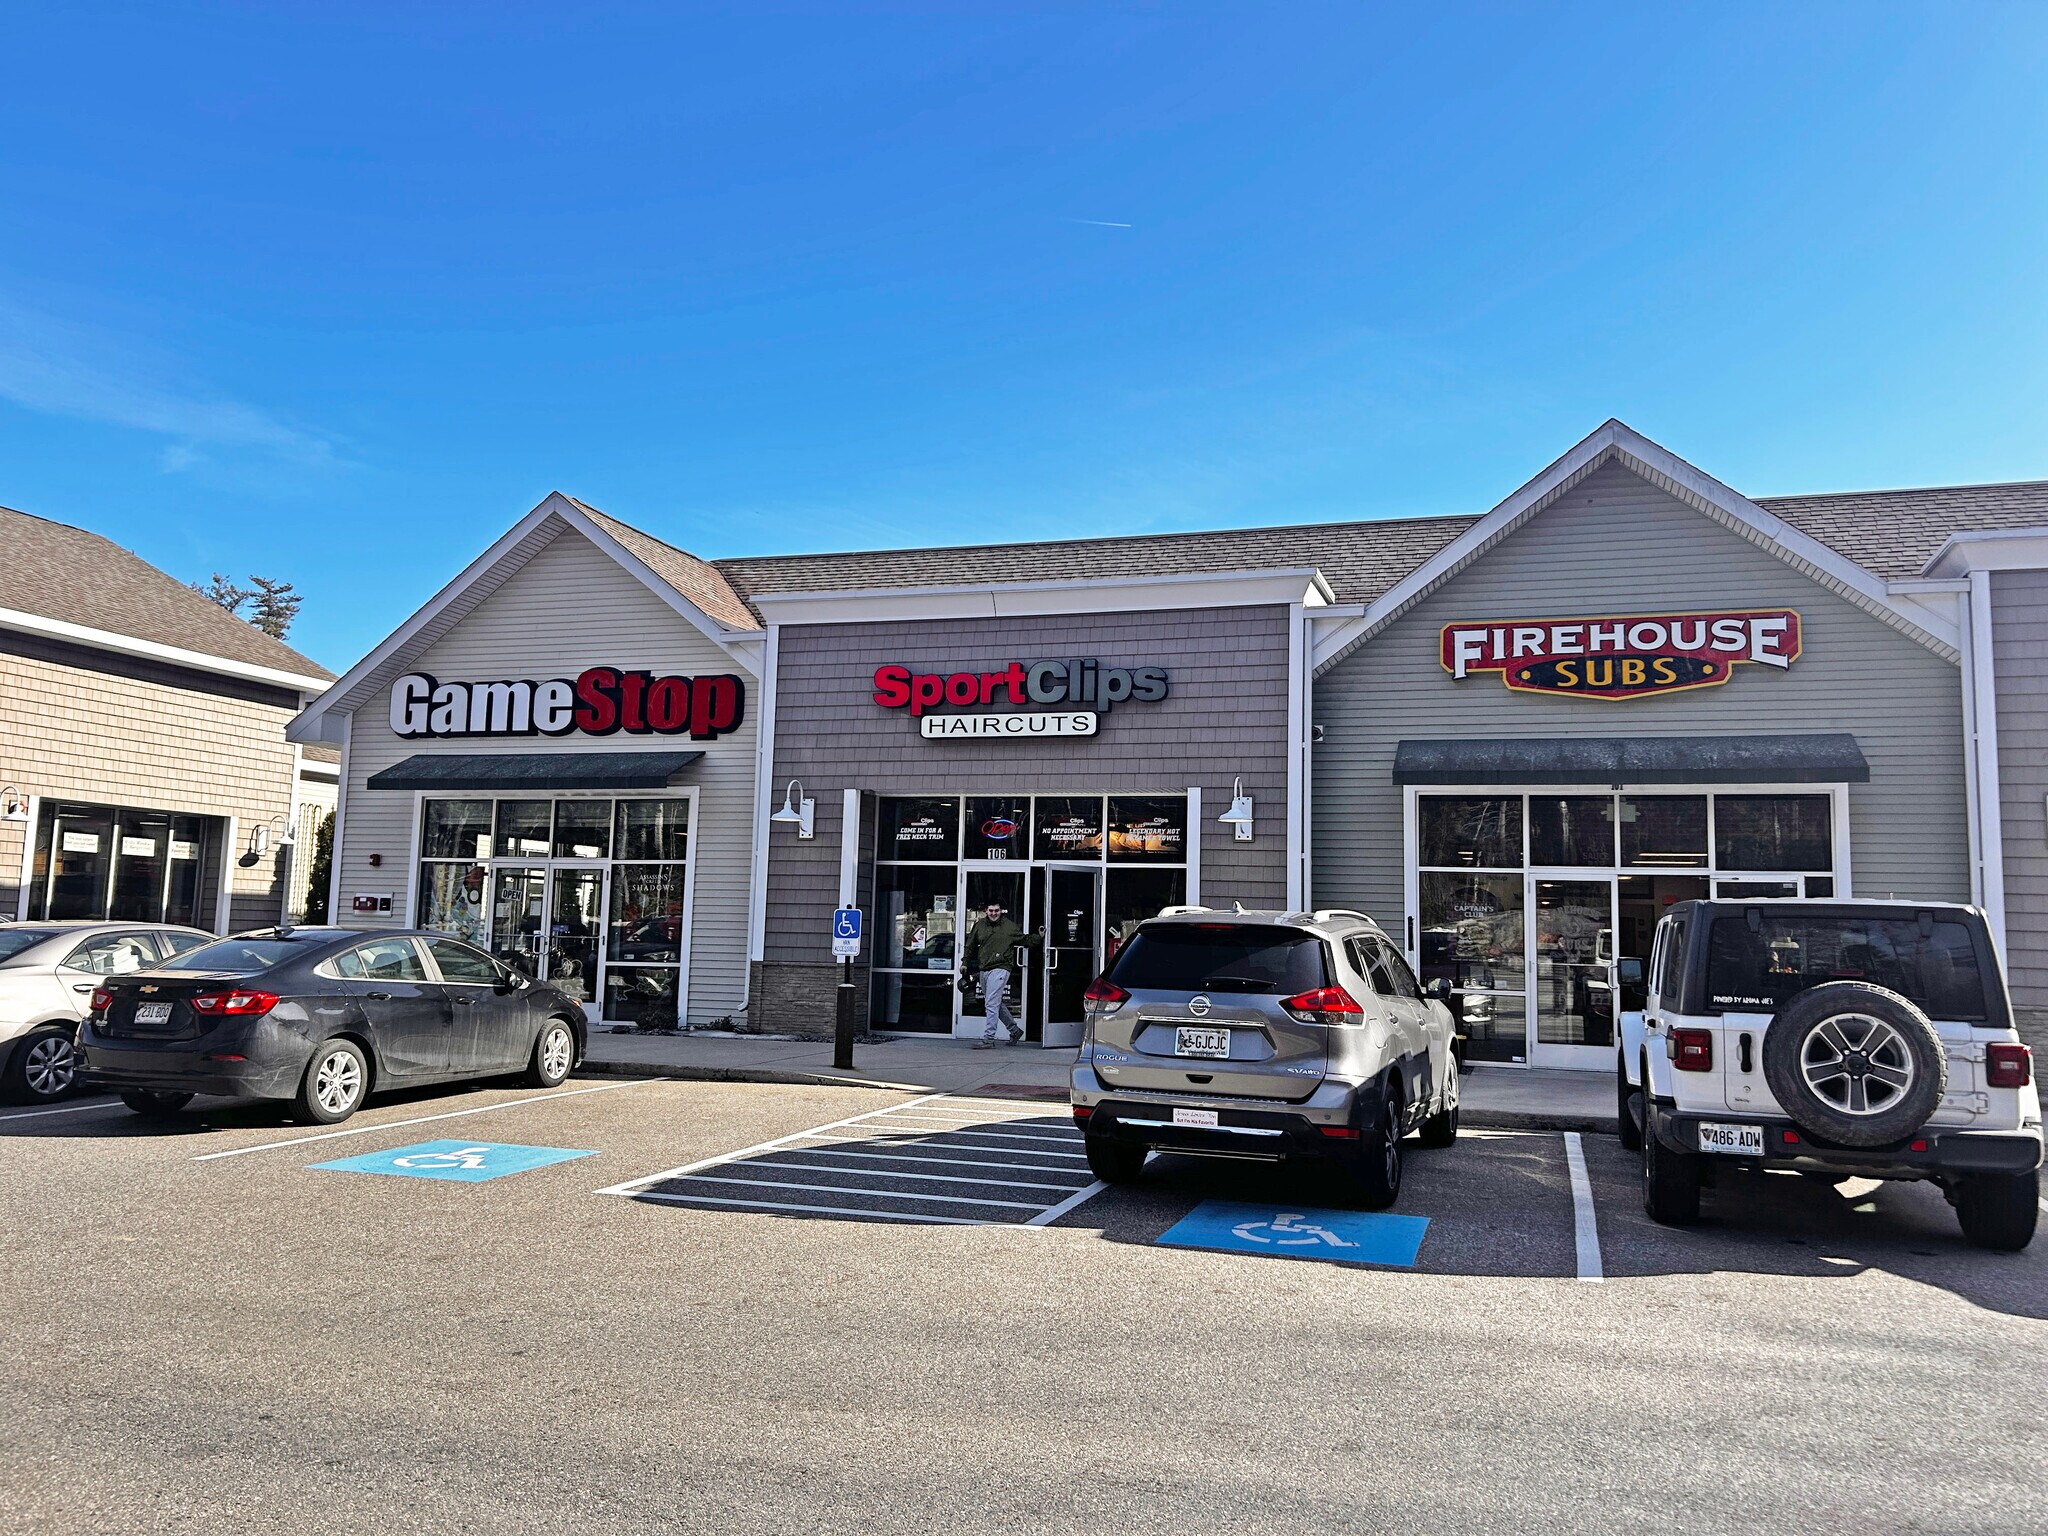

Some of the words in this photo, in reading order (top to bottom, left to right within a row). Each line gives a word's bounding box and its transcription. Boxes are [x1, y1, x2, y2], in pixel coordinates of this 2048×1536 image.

[1451, 614, 1791, 681] FIREHOUSE
[1556, 656, 1677, 688] SUBS
[388, 666, 745, 741] GameStop
[927, 715, 1090, 735] HAIRCUTS
[981, 820, 1017, 836] Open
[988, 849, 1006, 860] 106
[502, 889, 521, 900] OPEN
[632, 884, 675, 892] SHADOWS
[1454, 904, 1494, 913] CAPTAIN'S
[1713, 995, 1733, 1003] POWERED
[1195, 1035, 1227, 1050] GJCJC
[1096, 1054, 1128, 1062] ROGUE
[1711, 1130, 1761, 1148] 486-ADW
